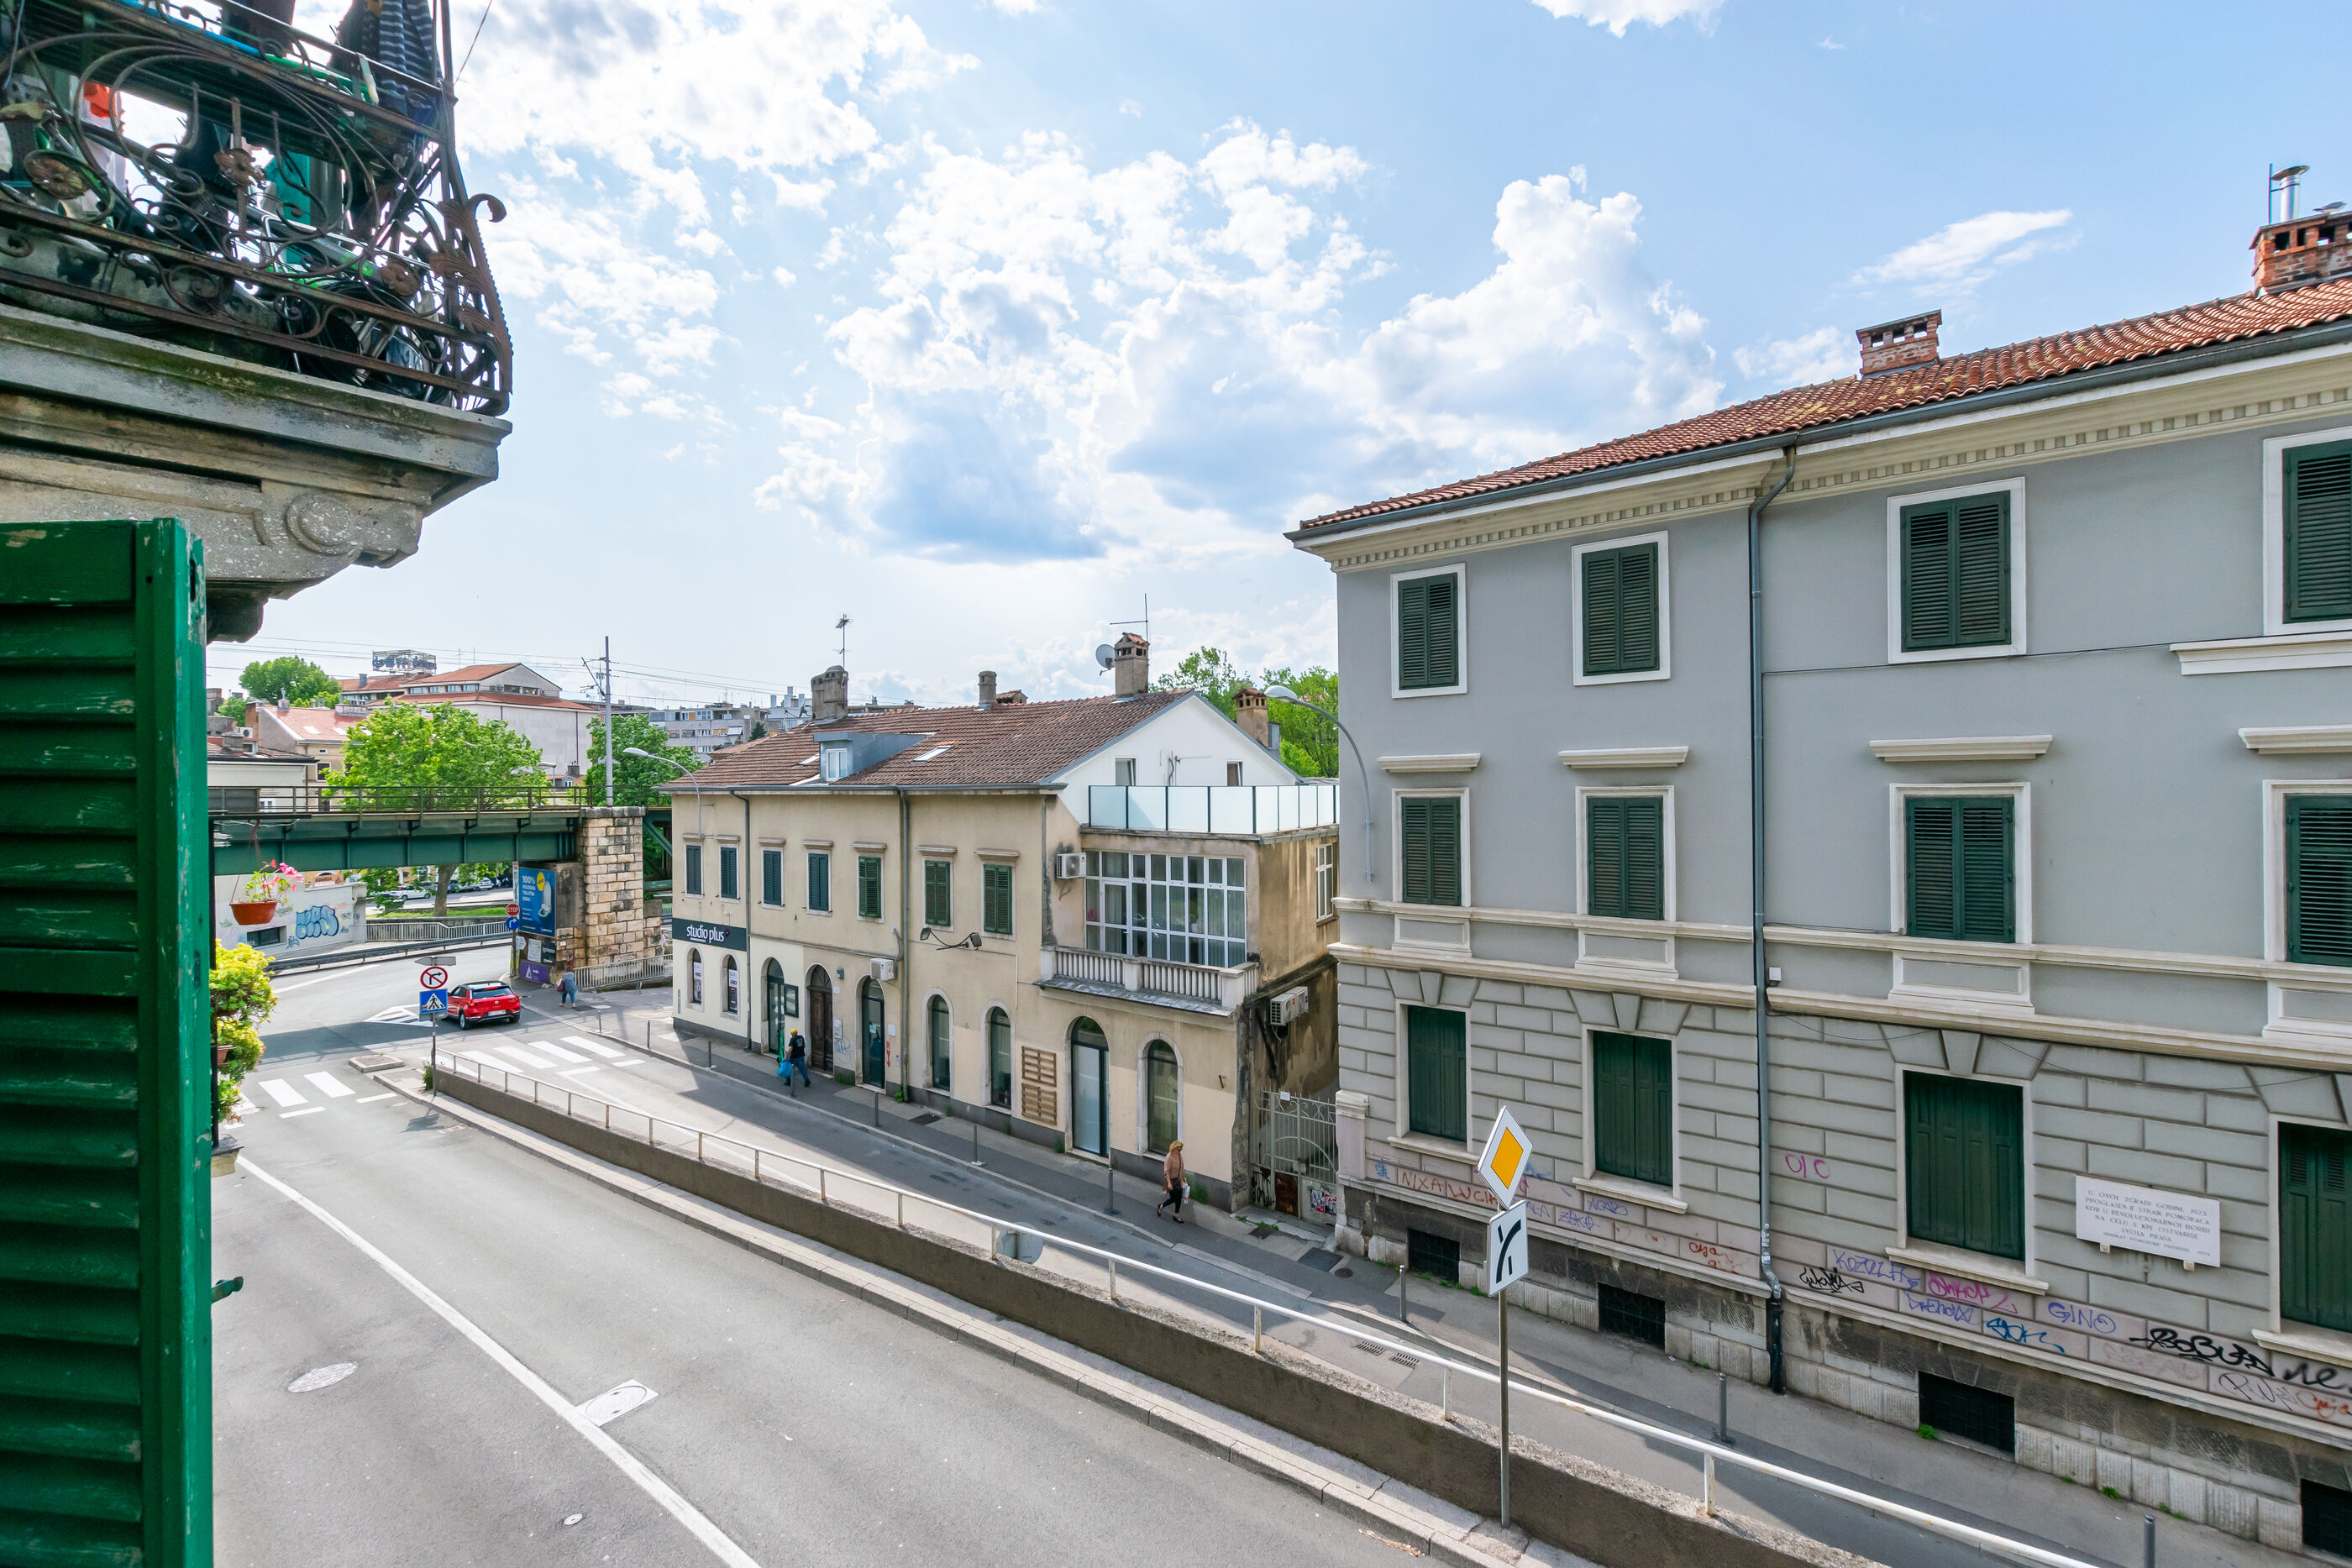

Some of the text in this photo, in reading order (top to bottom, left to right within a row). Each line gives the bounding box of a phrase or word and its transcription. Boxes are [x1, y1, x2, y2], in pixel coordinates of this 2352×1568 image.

[686, 925, 724, 944] studio plus
[1402, 1172, 1444, 1193] NIXA
[2155, 1202, 2184, 1213] GODINE
[2150, 1233, 2171, 1242] PRAVA
[2048, 1302, 2116, 1334] GINO
